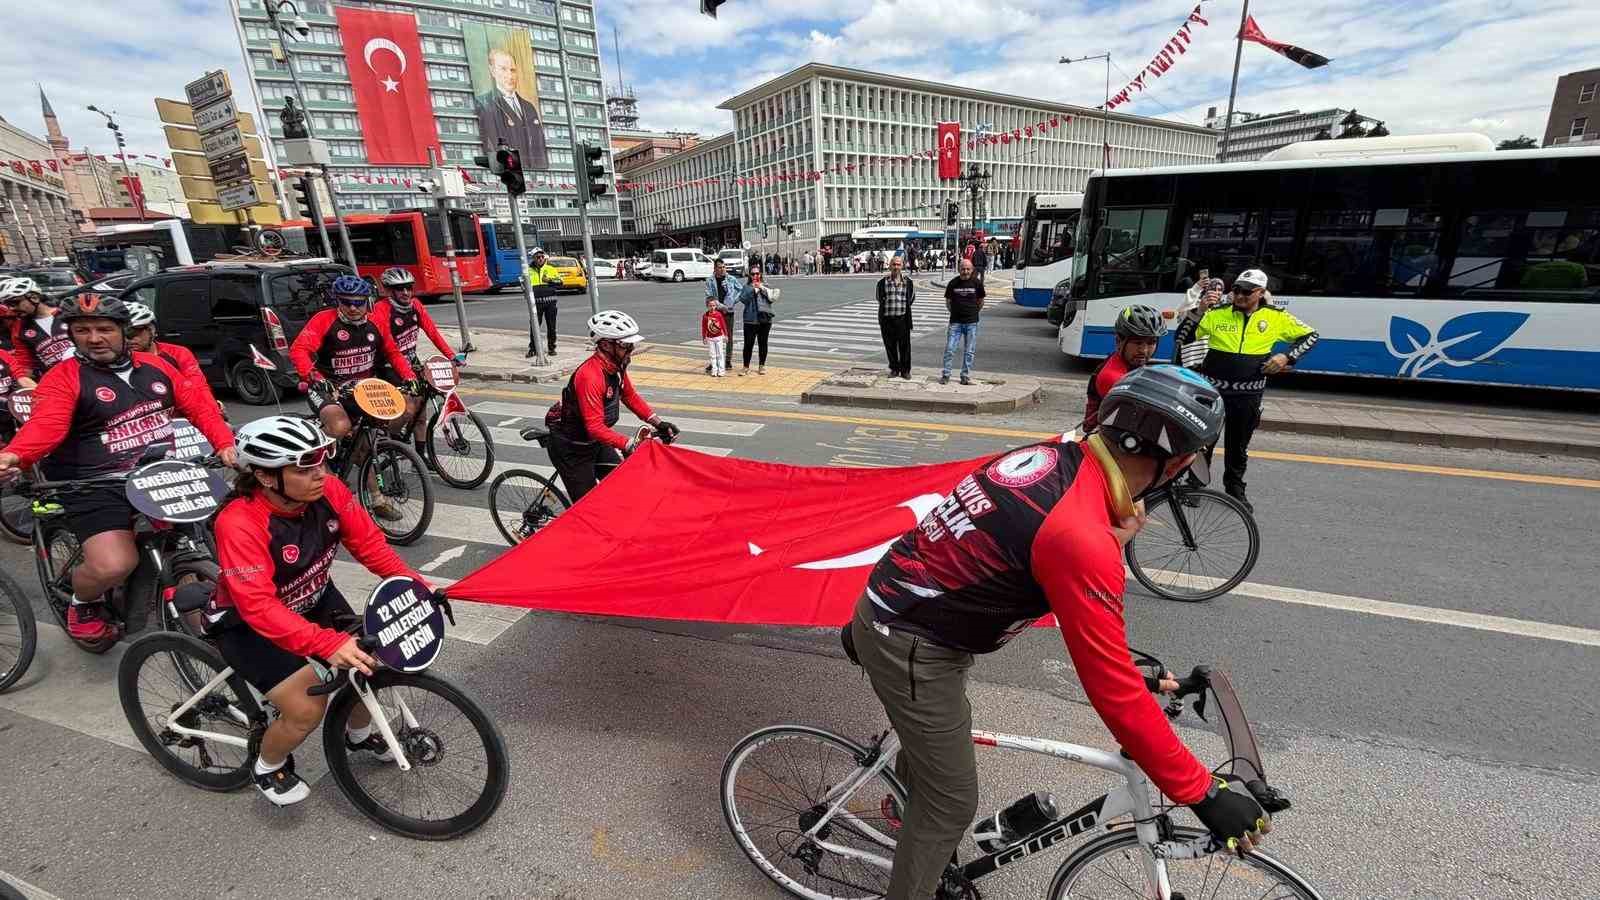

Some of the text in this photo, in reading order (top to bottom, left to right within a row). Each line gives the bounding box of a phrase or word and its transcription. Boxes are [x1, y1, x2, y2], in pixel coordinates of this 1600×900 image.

[132, 466, 209, 490] EMEĞİMİZİN
[148, 480, 210, 502] KARŞILIĞI
[161, 495, 217, 516] VERİLSİN
[376, 588, 418, 623] 12 YILLIK
[377, 599, 435, 647] ADALETSİZLİK
[399, 622, 436, 661] BİTSİN
